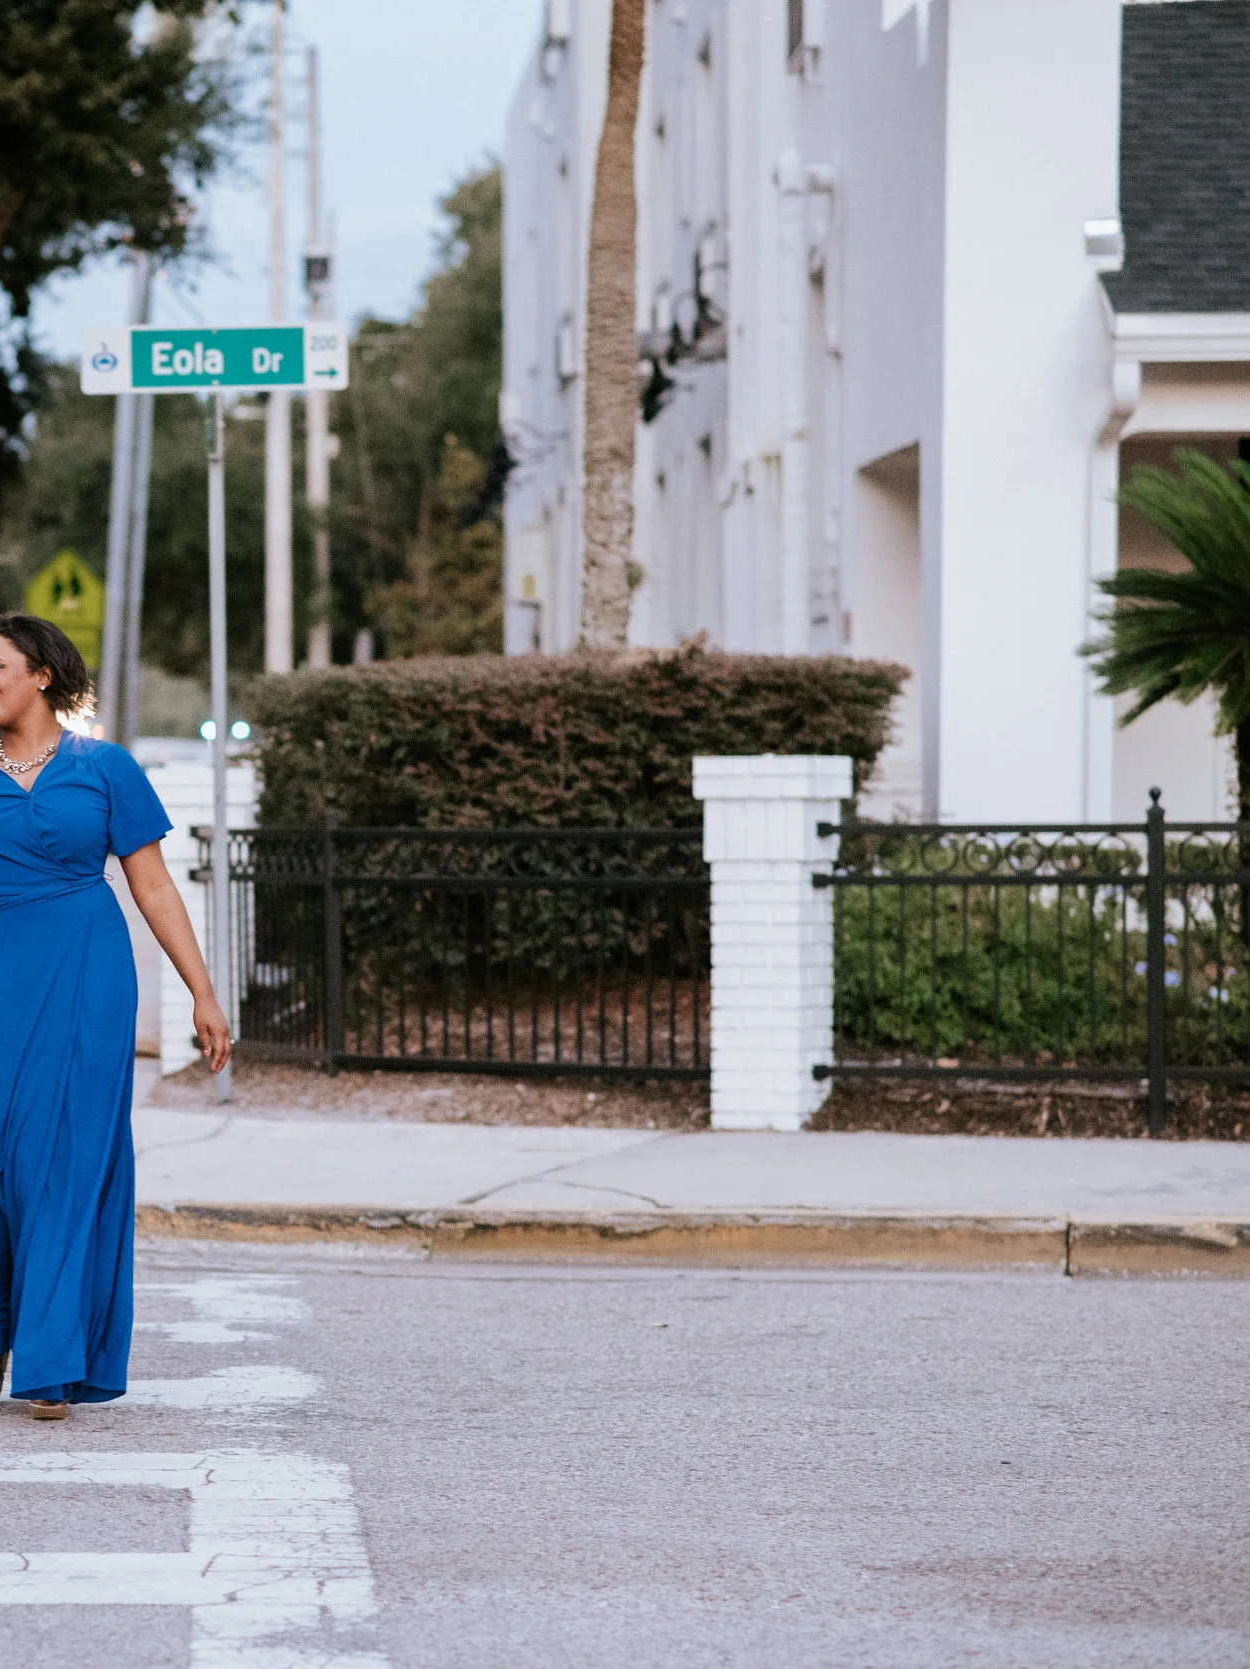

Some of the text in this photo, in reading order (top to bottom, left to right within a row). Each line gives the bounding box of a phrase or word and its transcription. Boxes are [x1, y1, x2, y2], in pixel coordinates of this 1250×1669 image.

[310, 335, 337, 351] 200
[152, 342, 283, 375] Eola Dr
